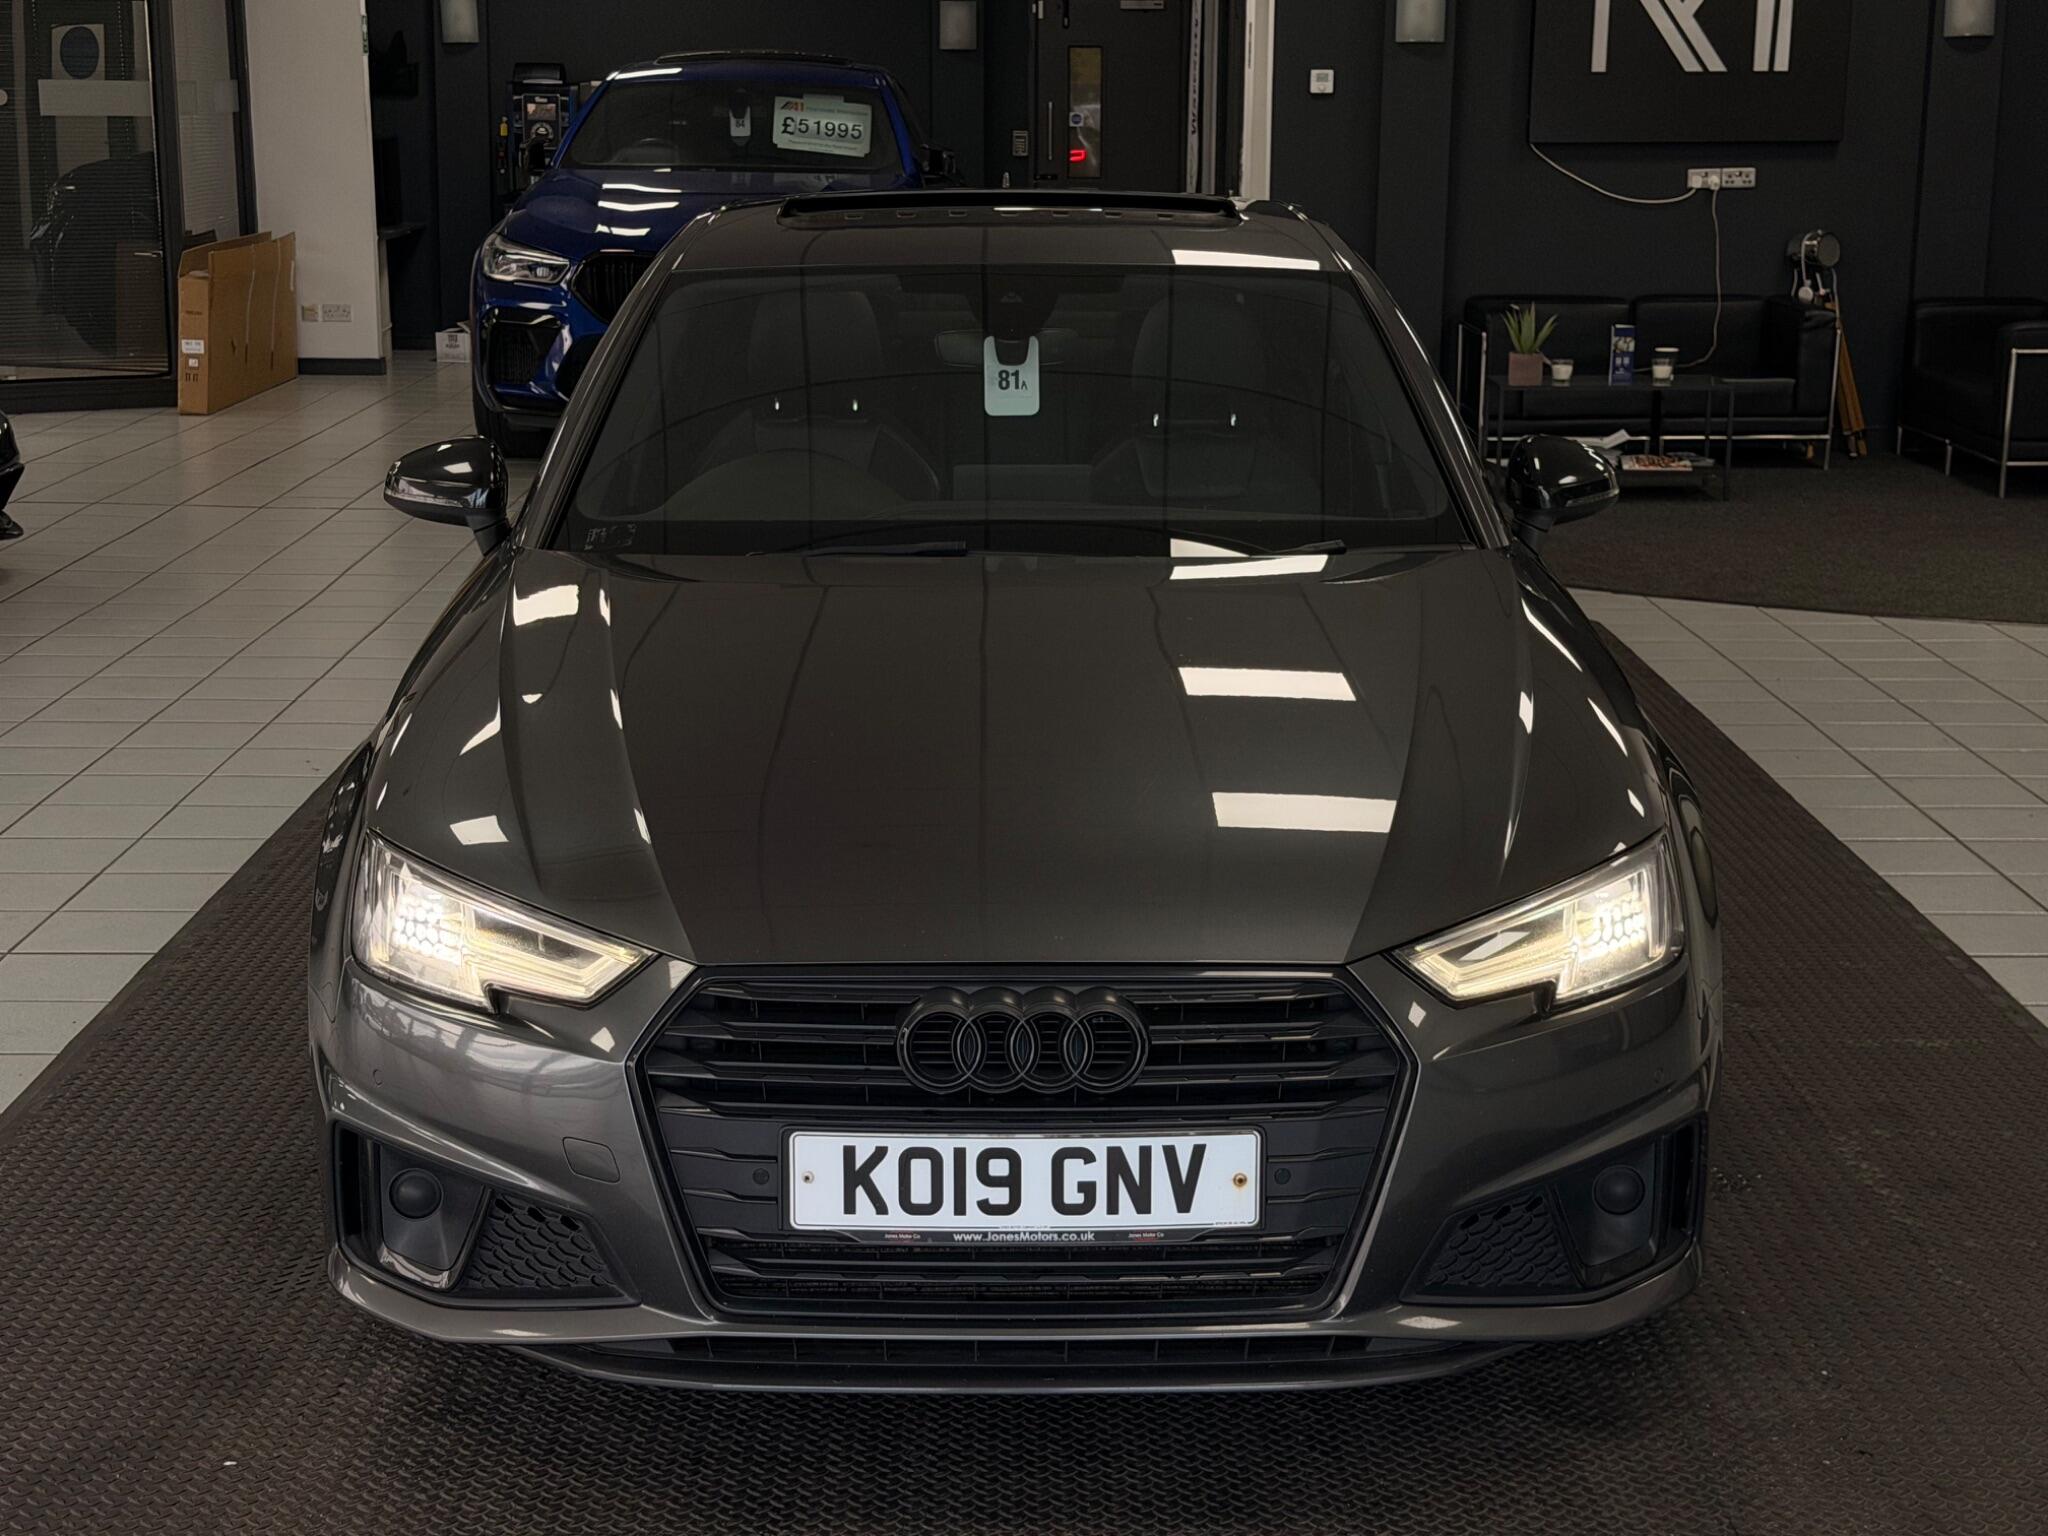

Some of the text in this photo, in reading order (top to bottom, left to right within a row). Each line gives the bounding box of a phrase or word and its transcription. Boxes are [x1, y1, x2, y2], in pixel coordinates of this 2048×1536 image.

[781, 116, 863, 140] £51995
[843, 1143, 1207, 1217] KO19 GNV
[953, 1230, 1096, 1242] www.JonesMotors.co.uk
